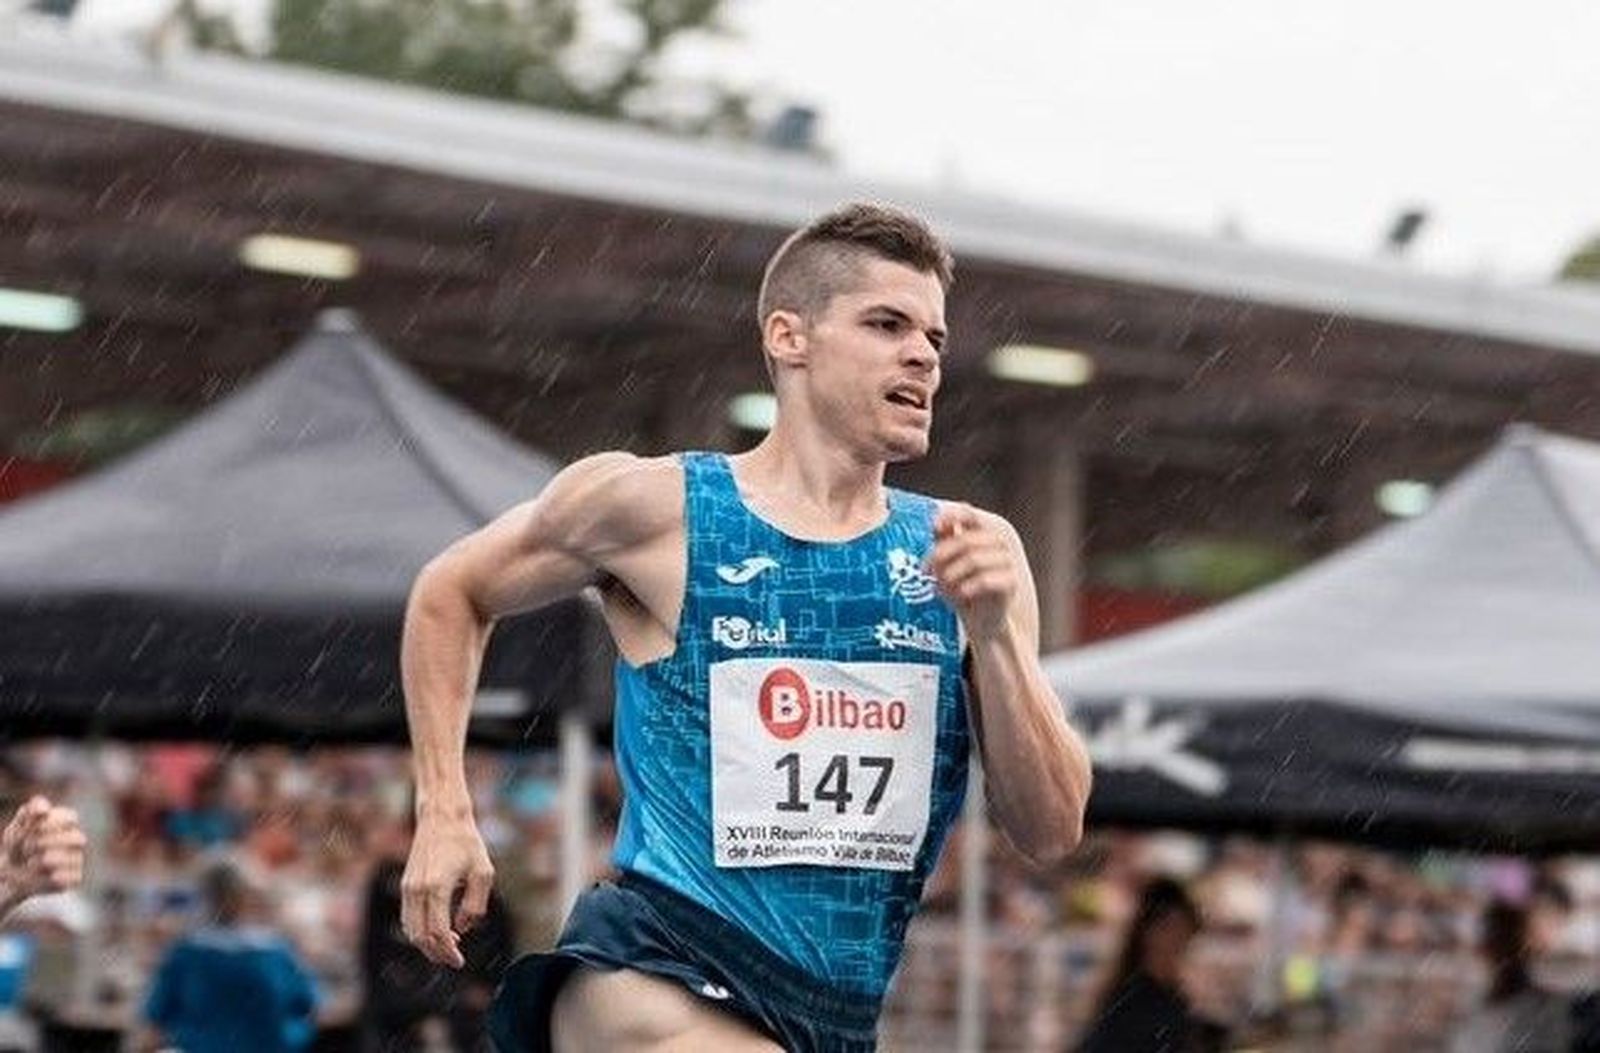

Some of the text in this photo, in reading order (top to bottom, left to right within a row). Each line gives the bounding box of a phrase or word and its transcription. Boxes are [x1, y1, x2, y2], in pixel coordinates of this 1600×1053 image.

[763, 674, 906, 736] Bilbao
[774, 752, 894, 815] 147
[727, 826, 767, 841] XVIII
[727, 844, 748, 859] de
